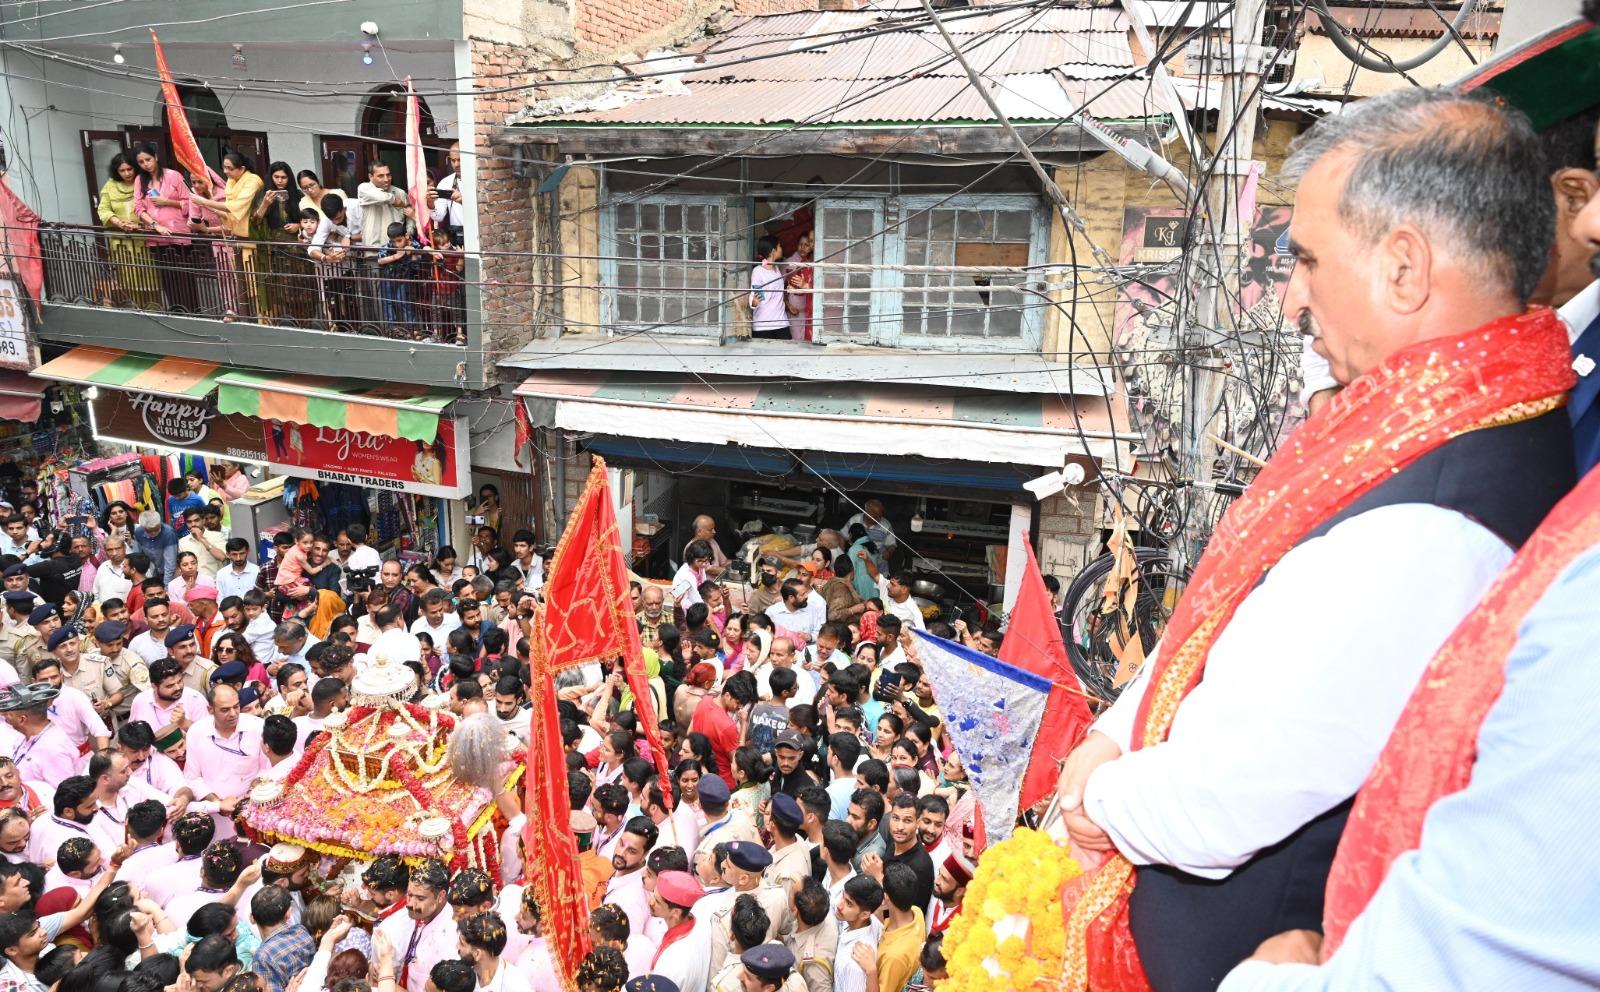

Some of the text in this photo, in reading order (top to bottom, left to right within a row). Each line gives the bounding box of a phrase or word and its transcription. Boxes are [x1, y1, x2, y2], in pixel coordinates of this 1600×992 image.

[129, 391, 217, 427] Happy
[156, 426, 198, 438] CLOTH SHOP
[158, 416, 195, 430] HOUSE
[315, 427, 385, 461] Lyra
[318, 471, 405, 489] BHARAT TRADERS
